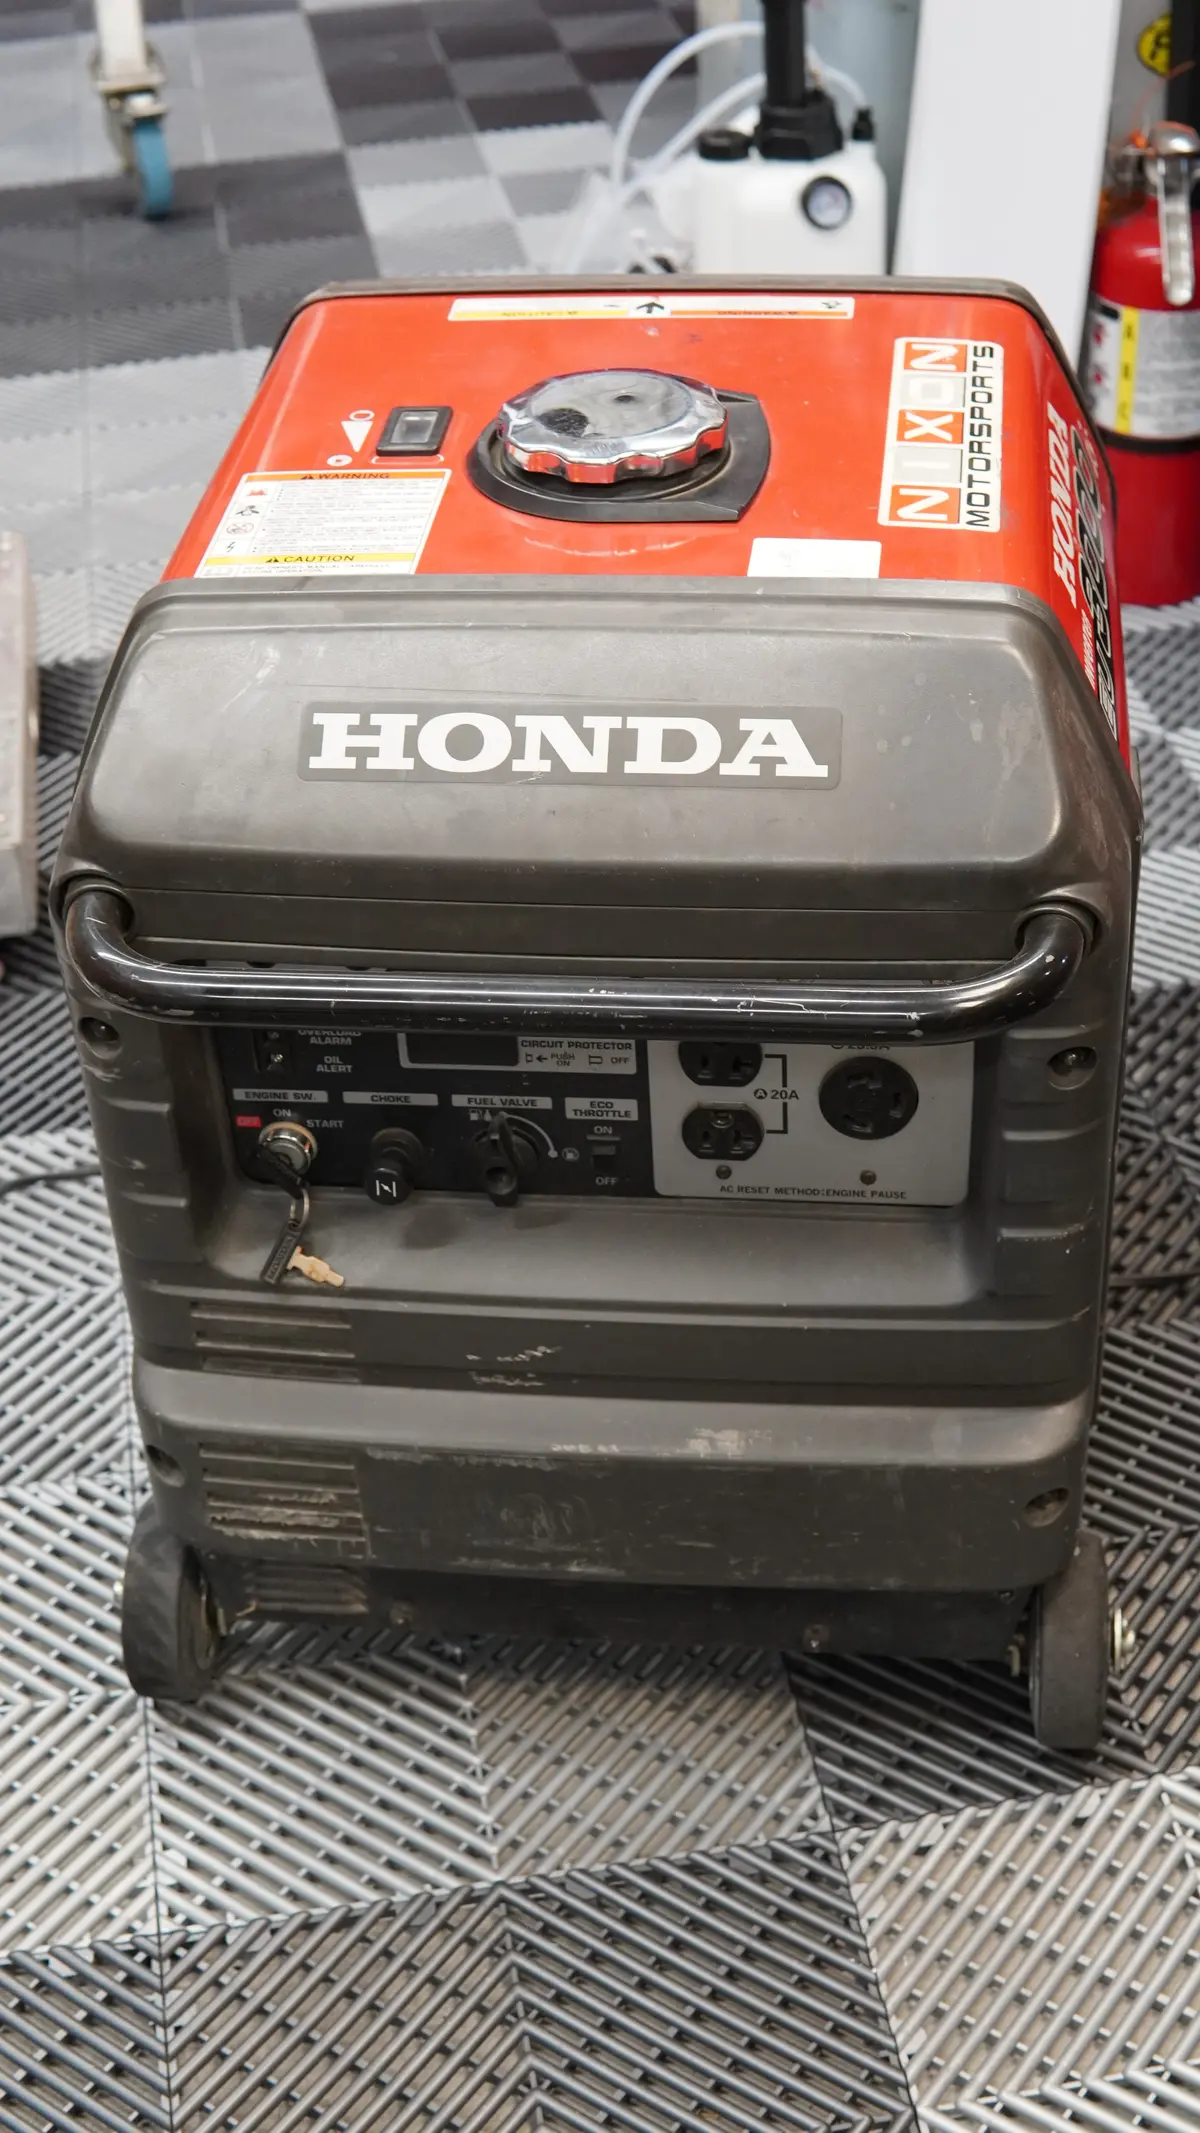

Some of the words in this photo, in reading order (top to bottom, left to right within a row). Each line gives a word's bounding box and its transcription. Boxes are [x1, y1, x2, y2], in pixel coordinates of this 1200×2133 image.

[896, 343, 959, 521] NIXON
[965, 345, 994, 527] MOTORSPORTS
[317, 472, 391, 480] WARNING
[1047, 401, 1077, 609] HONDA
[282, 554, 356, 563] CAUTION
[308, 711, 829, 778] HONDA
[310, 1036, 352, 1045] ALARM
[520, 1039, 564, 1049] CIRCUIT
[567, 1040, 632, 1050] PROTECTOR
[324, 1055, 343, 1064] OIL
[550, 1053, 575, 1061] PUSH
[610, 1056, 630, 1064] OFF
[556, 1059, 571, 1067] ON
[316, 1064, 353, 1073] ALERT
[244, 1090, 289, 1100] ENGINE
[293, 1091, 316, 1101] SW.
[370, 1094, 412, 1103] CHOKE
[770, 1089, 800, 1100] 20A
[467, 1097, 497, 1106] FUEL
[500, 1098, 538, 1107] VALVE
[589, 1100, 614, 1109] ECO
[272, 1108, 292, 1117] ON
[572, 1109, 632, 1119] THROTTLE
[305, 1119, 345, 1129] START
[593, 1125, 613, 1134] ON
[595, 1176, 618, 1186] OFF
[719, 1185, 734, 1193] AC
[737, 1185, 770, 1194] RESET
[870, 1190, 907, 1200] PAUSE
